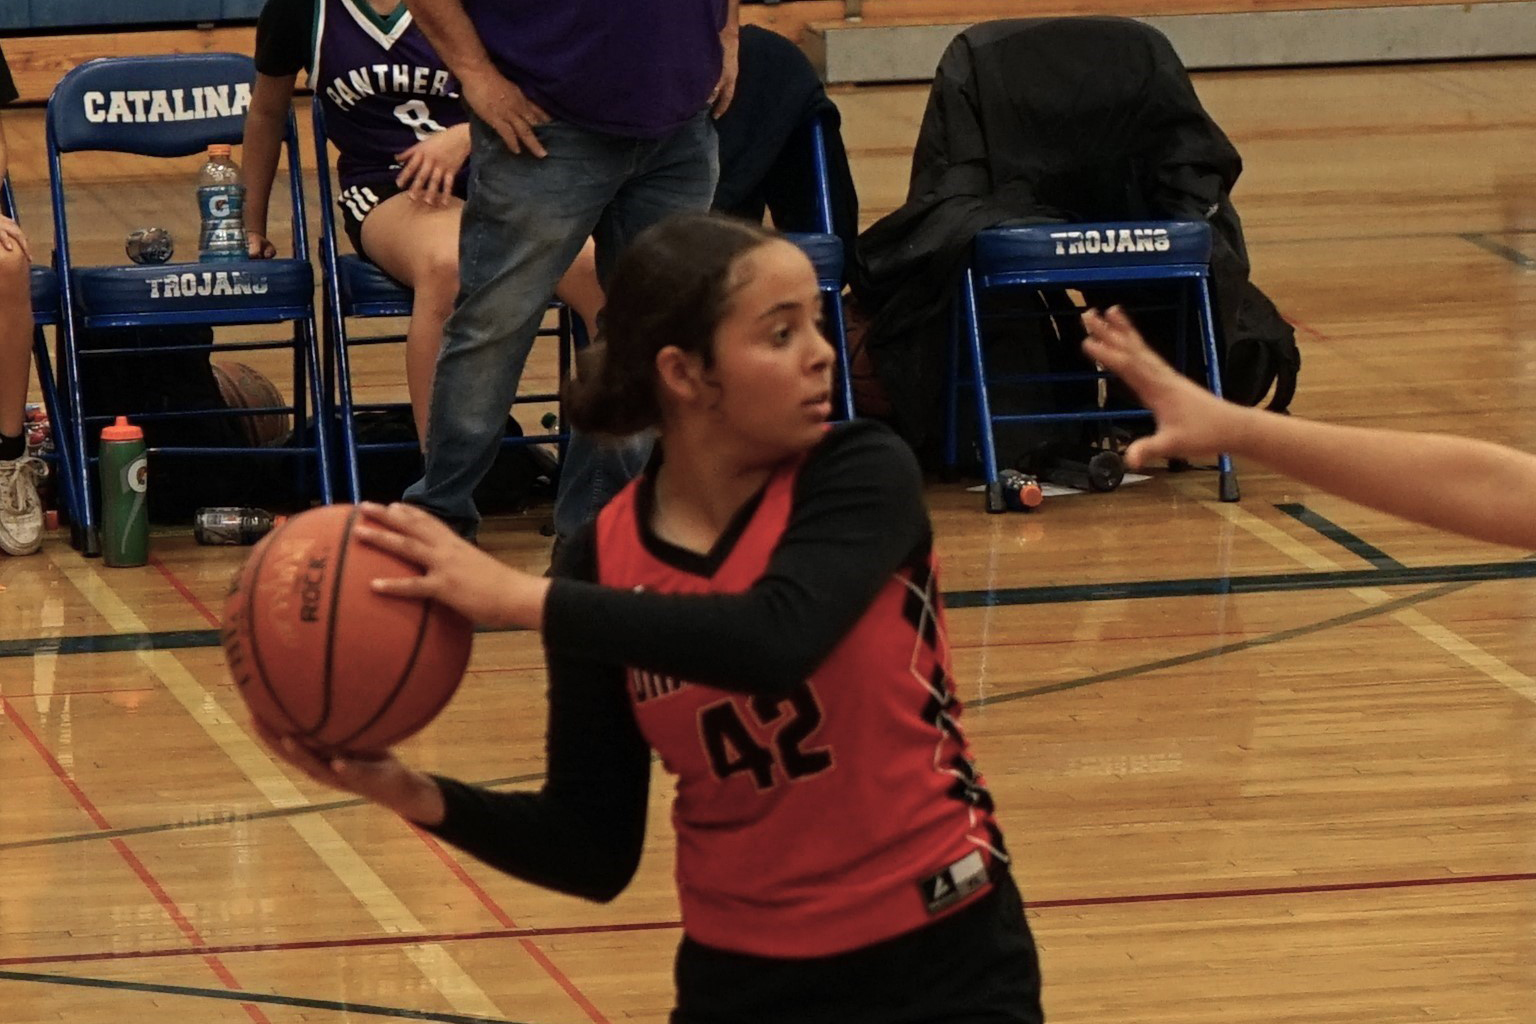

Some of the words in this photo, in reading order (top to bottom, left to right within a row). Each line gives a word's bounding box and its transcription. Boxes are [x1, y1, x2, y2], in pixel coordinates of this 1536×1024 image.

[83, 82, 253, 123] CATALINA
[326, 63, 460, 112] PANTHER
[393, 99, 448, 142] 8
[208, 194, 231, 218] G
[1050, 228, 1171, 255] TROJANS
[696, 676, 836, 793] 42
